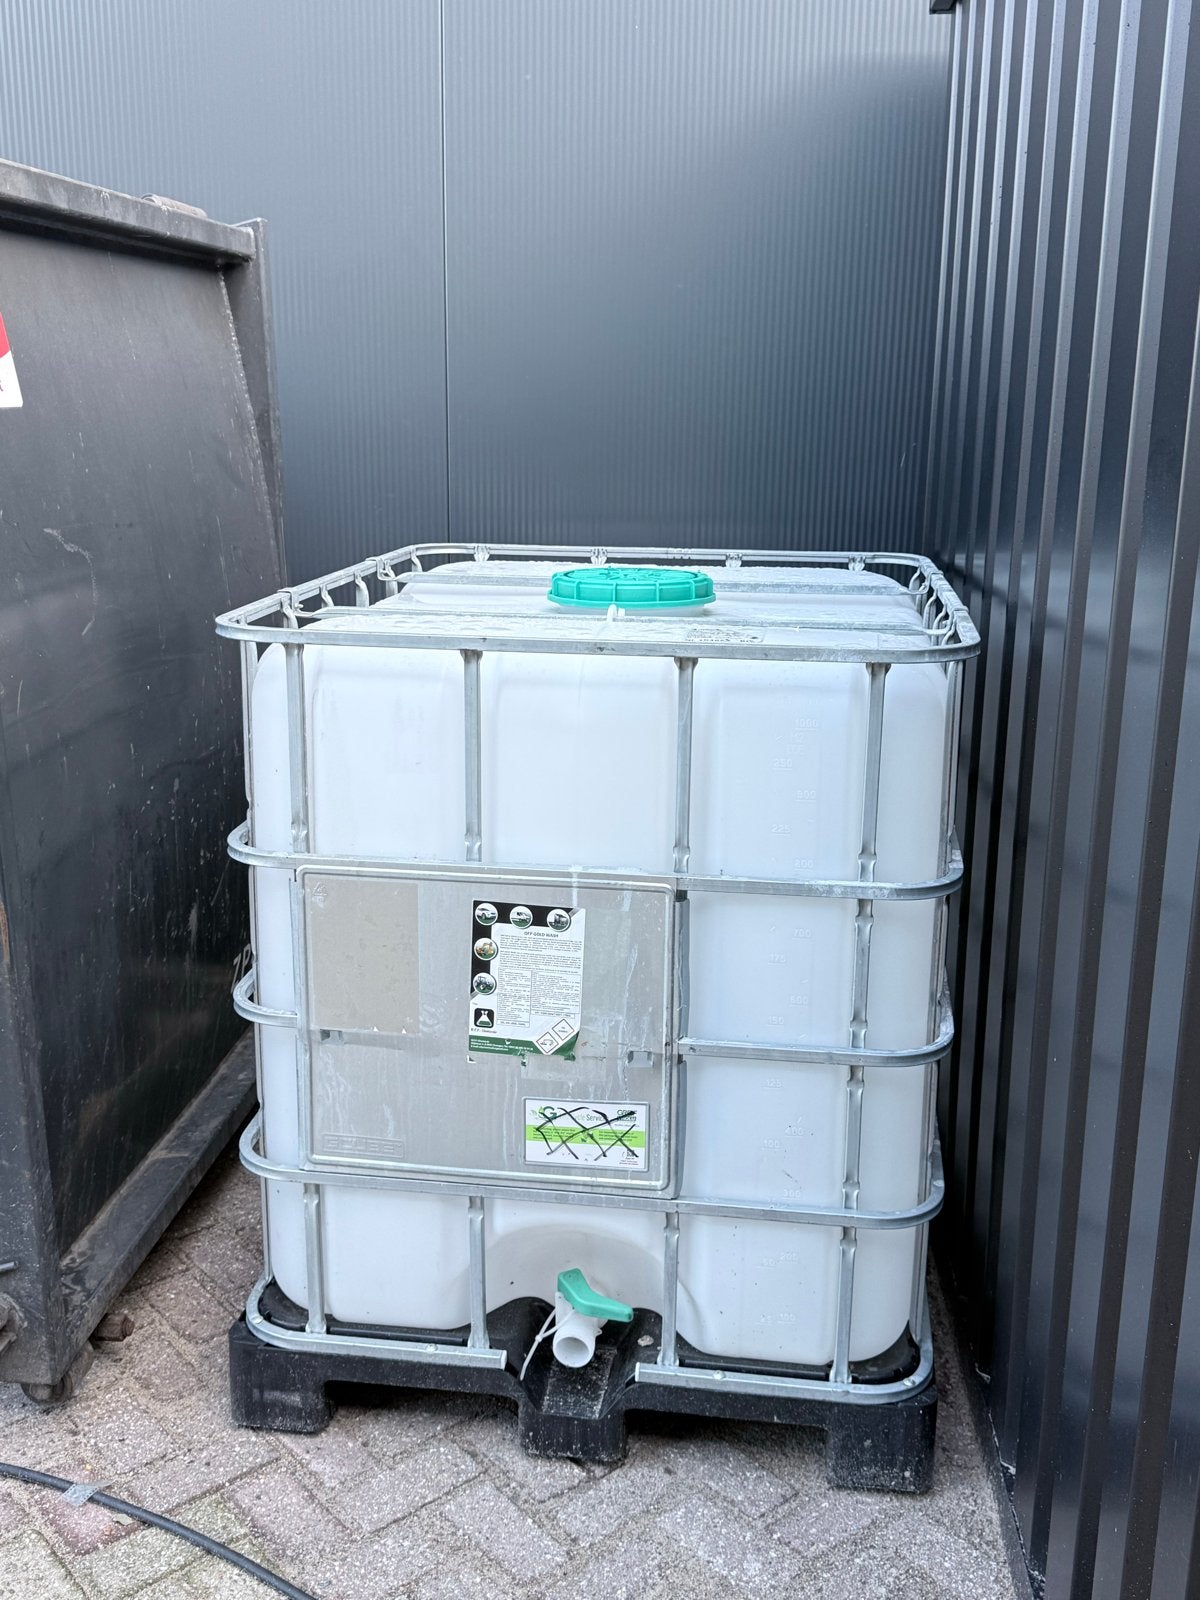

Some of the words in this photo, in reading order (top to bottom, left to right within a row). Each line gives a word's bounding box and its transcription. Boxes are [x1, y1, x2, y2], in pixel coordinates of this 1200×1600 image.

[773, 758, 793, 768] 250
[771, 824, 791, 834] 225
[794, 928, 812, 938] 700
[768, 1015, 785, 1025] 150
